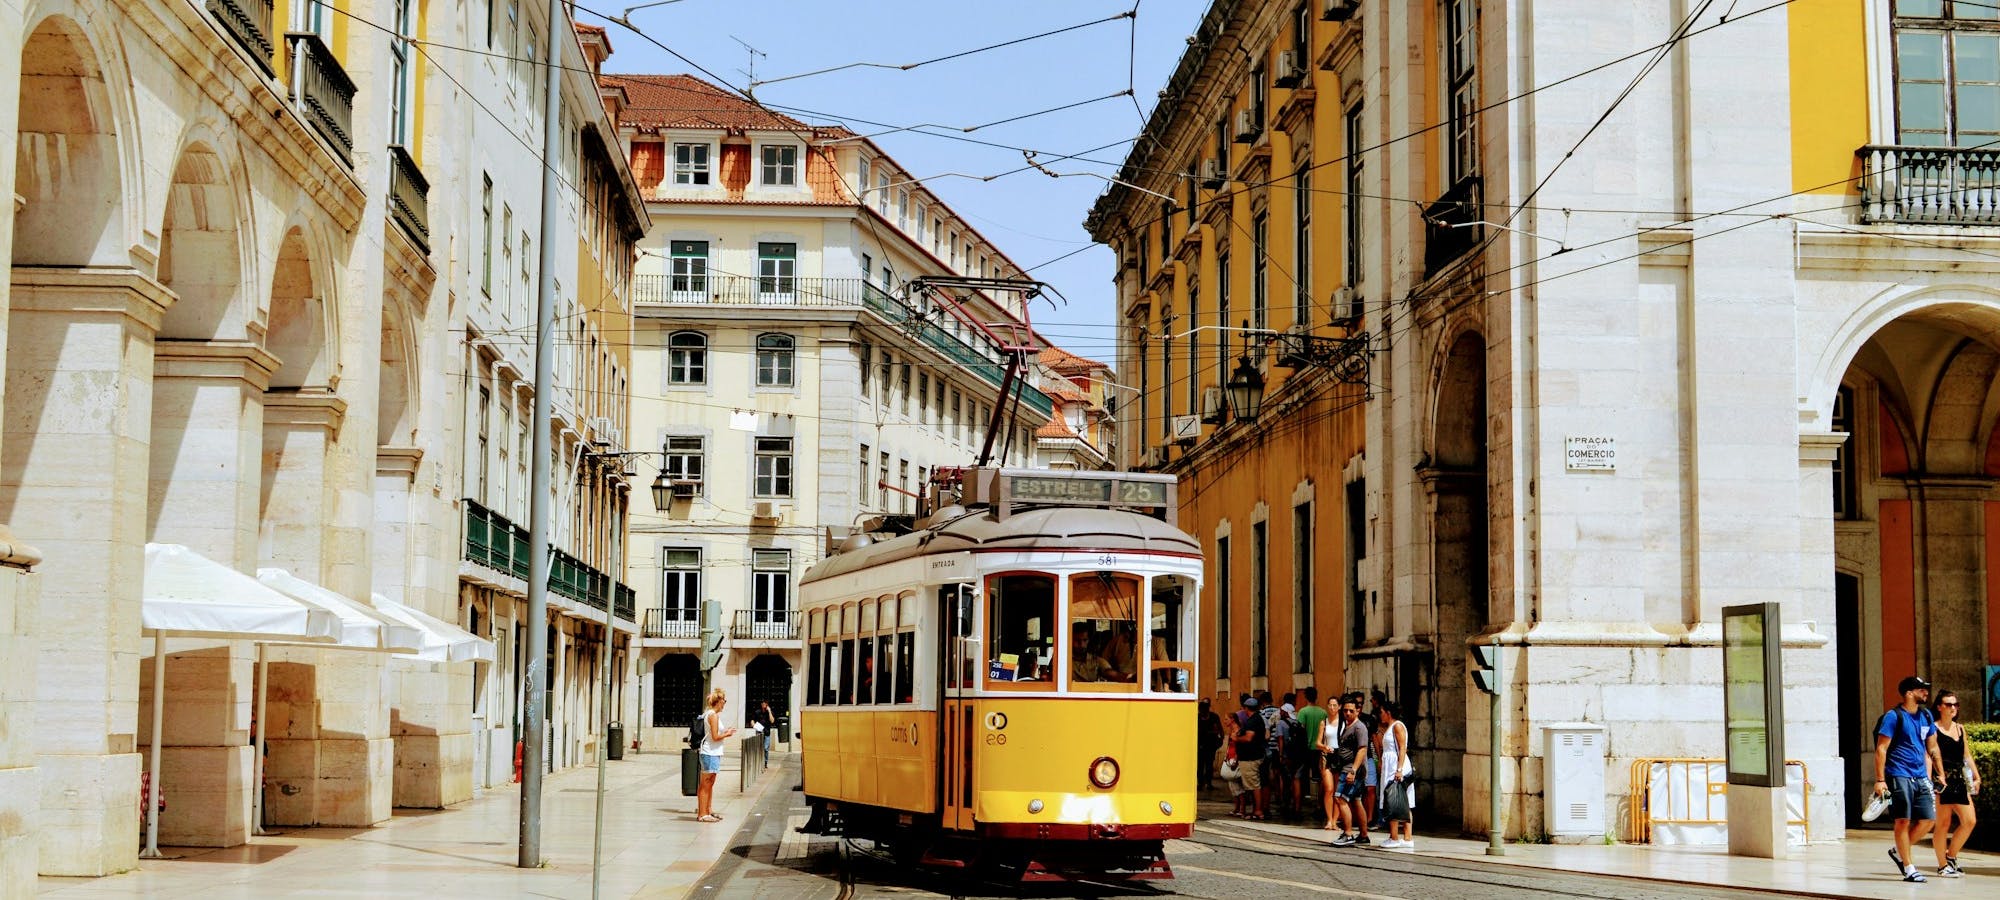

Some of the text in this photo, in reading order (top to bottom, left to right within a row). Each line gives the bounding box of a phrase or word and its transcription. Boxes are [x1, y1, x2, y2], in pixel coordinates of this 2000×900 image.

[1574, 437, 1608, 445] PRAÇA
[1568, 449, 1615, 458] COMERCIO
[1016, 479, 1105, 497] ESTRELA
[1122, 481, 1152, 502] 25
[1098, 555, 1117, 566] 581
[990, 670, 1000, 679] 01
